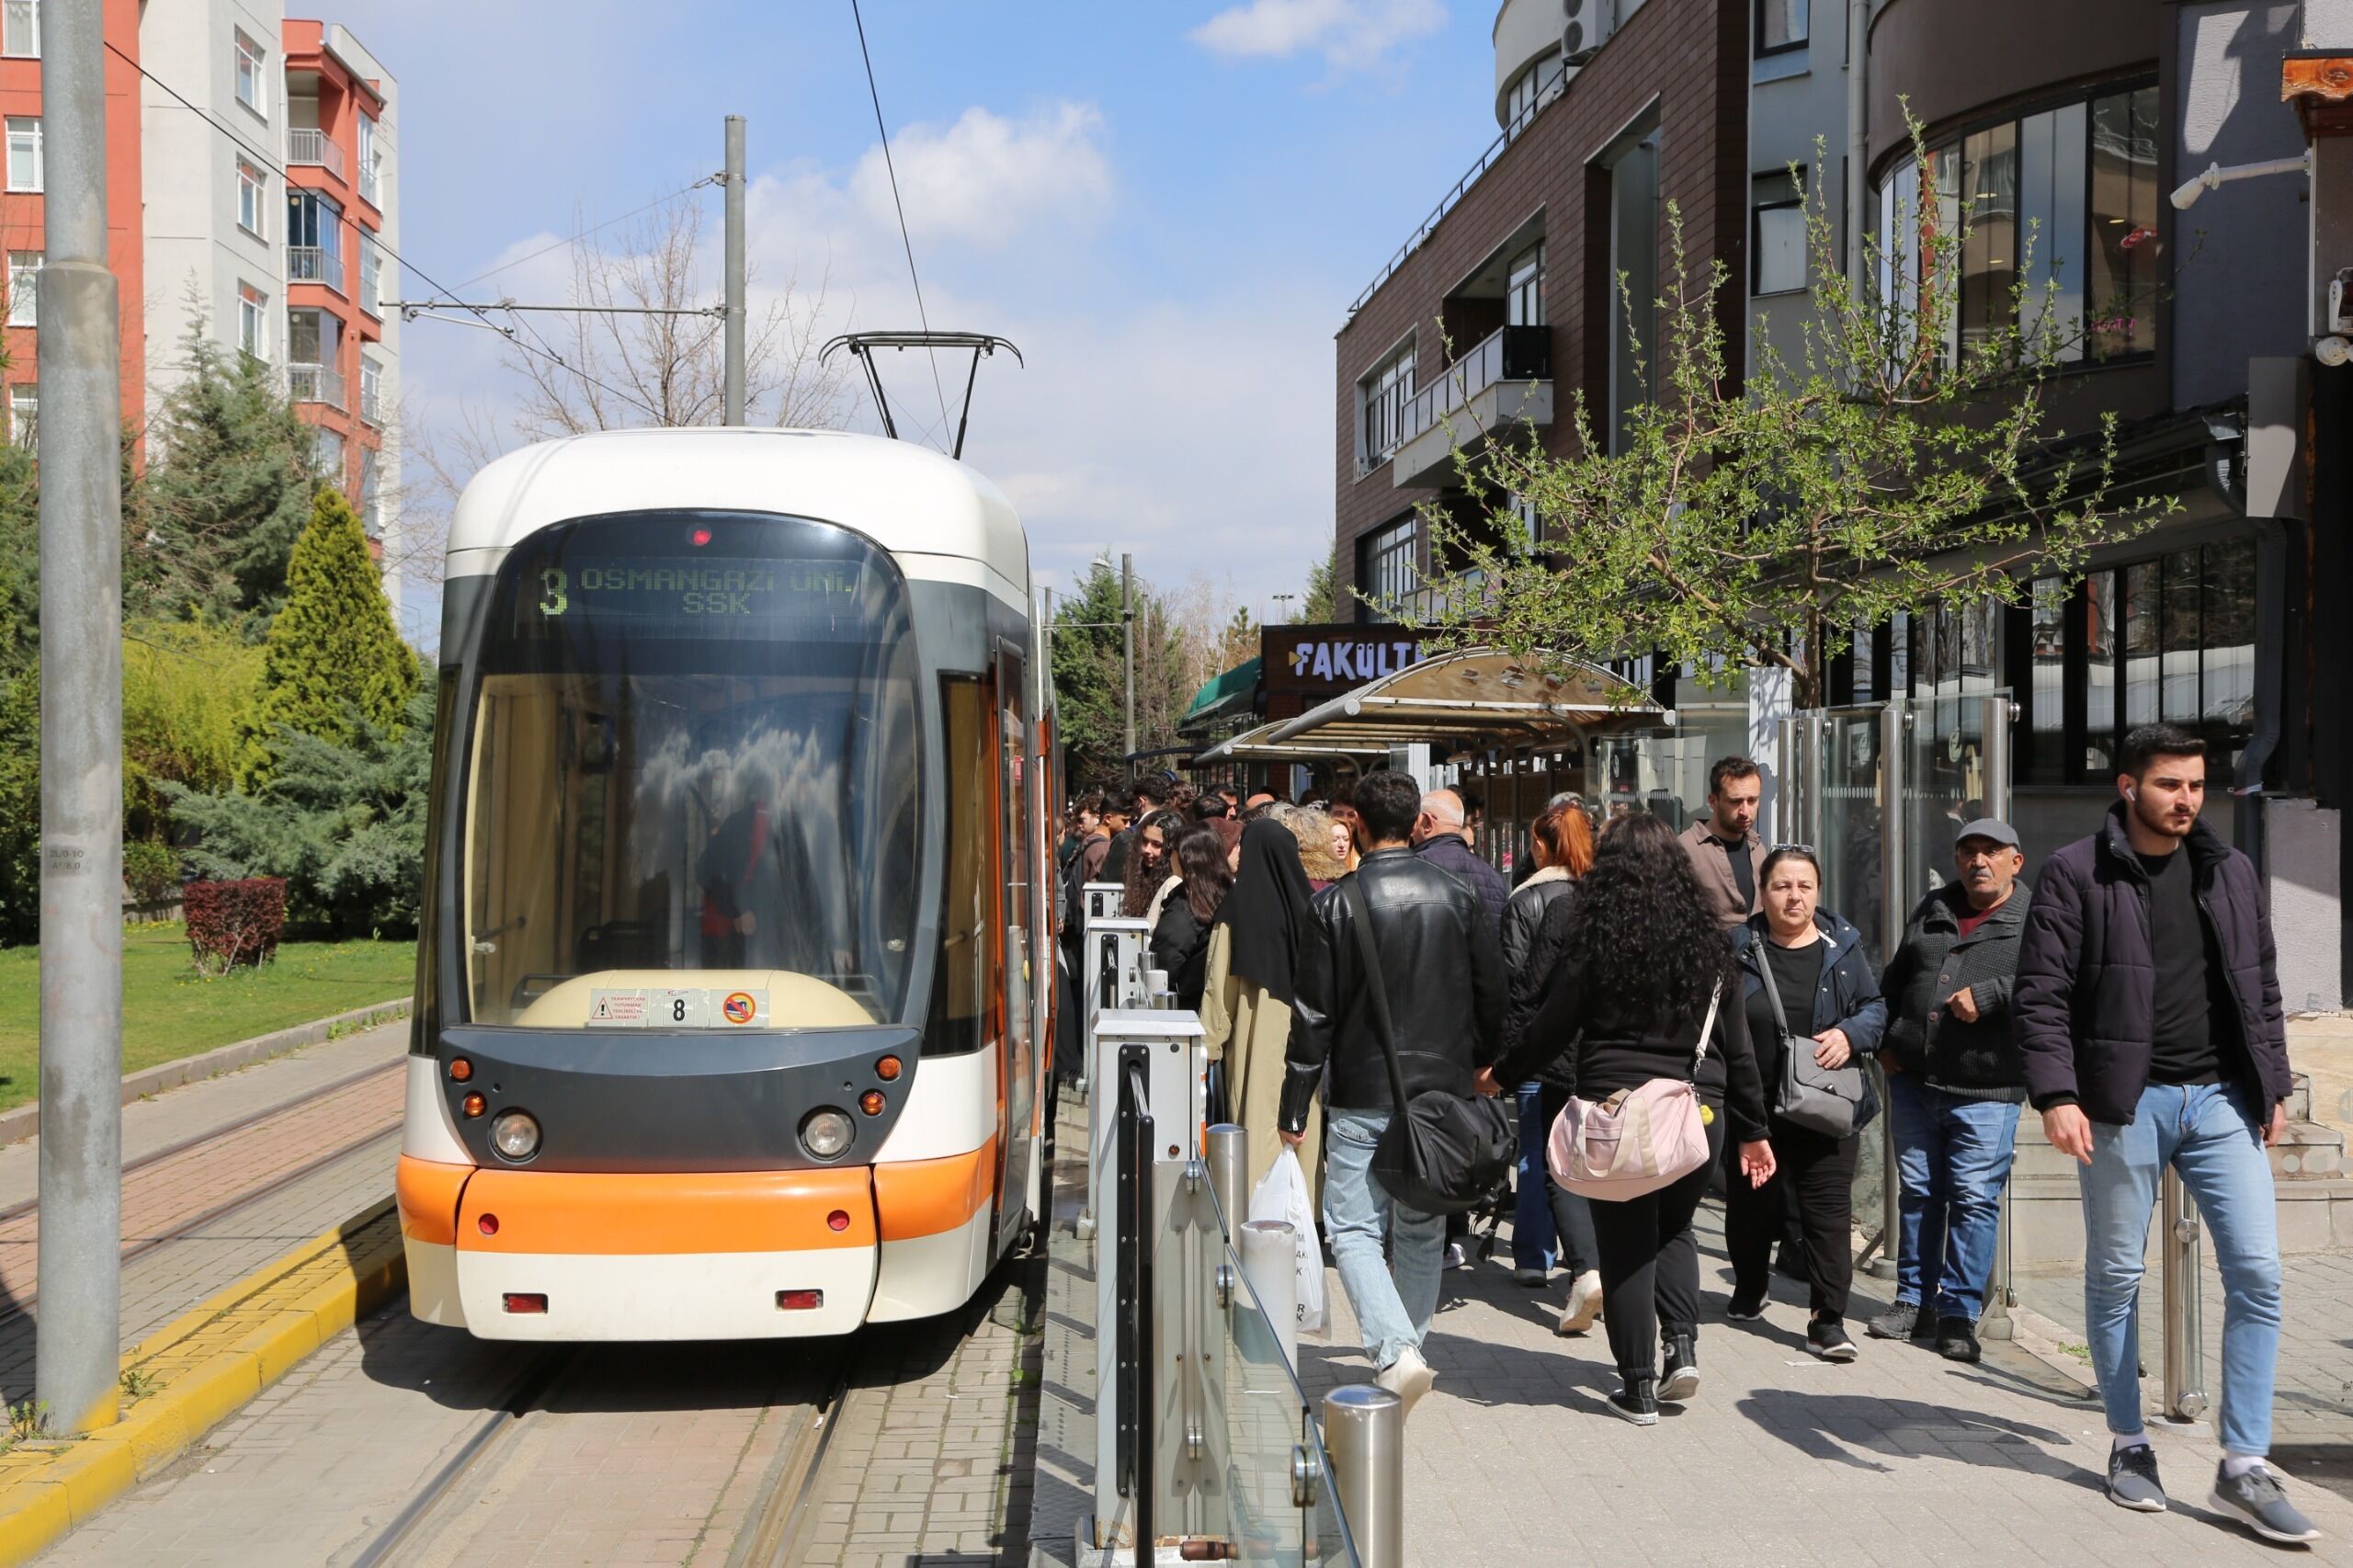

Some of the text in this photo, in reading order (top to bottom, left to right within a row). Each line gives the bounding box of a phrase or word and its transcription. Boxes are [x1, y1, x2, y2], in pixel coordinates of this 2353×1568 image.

[540, 568, 567, 615] 3
[683, 592, 751, 614] SSK
[673, 999, 685, 1021] 8
